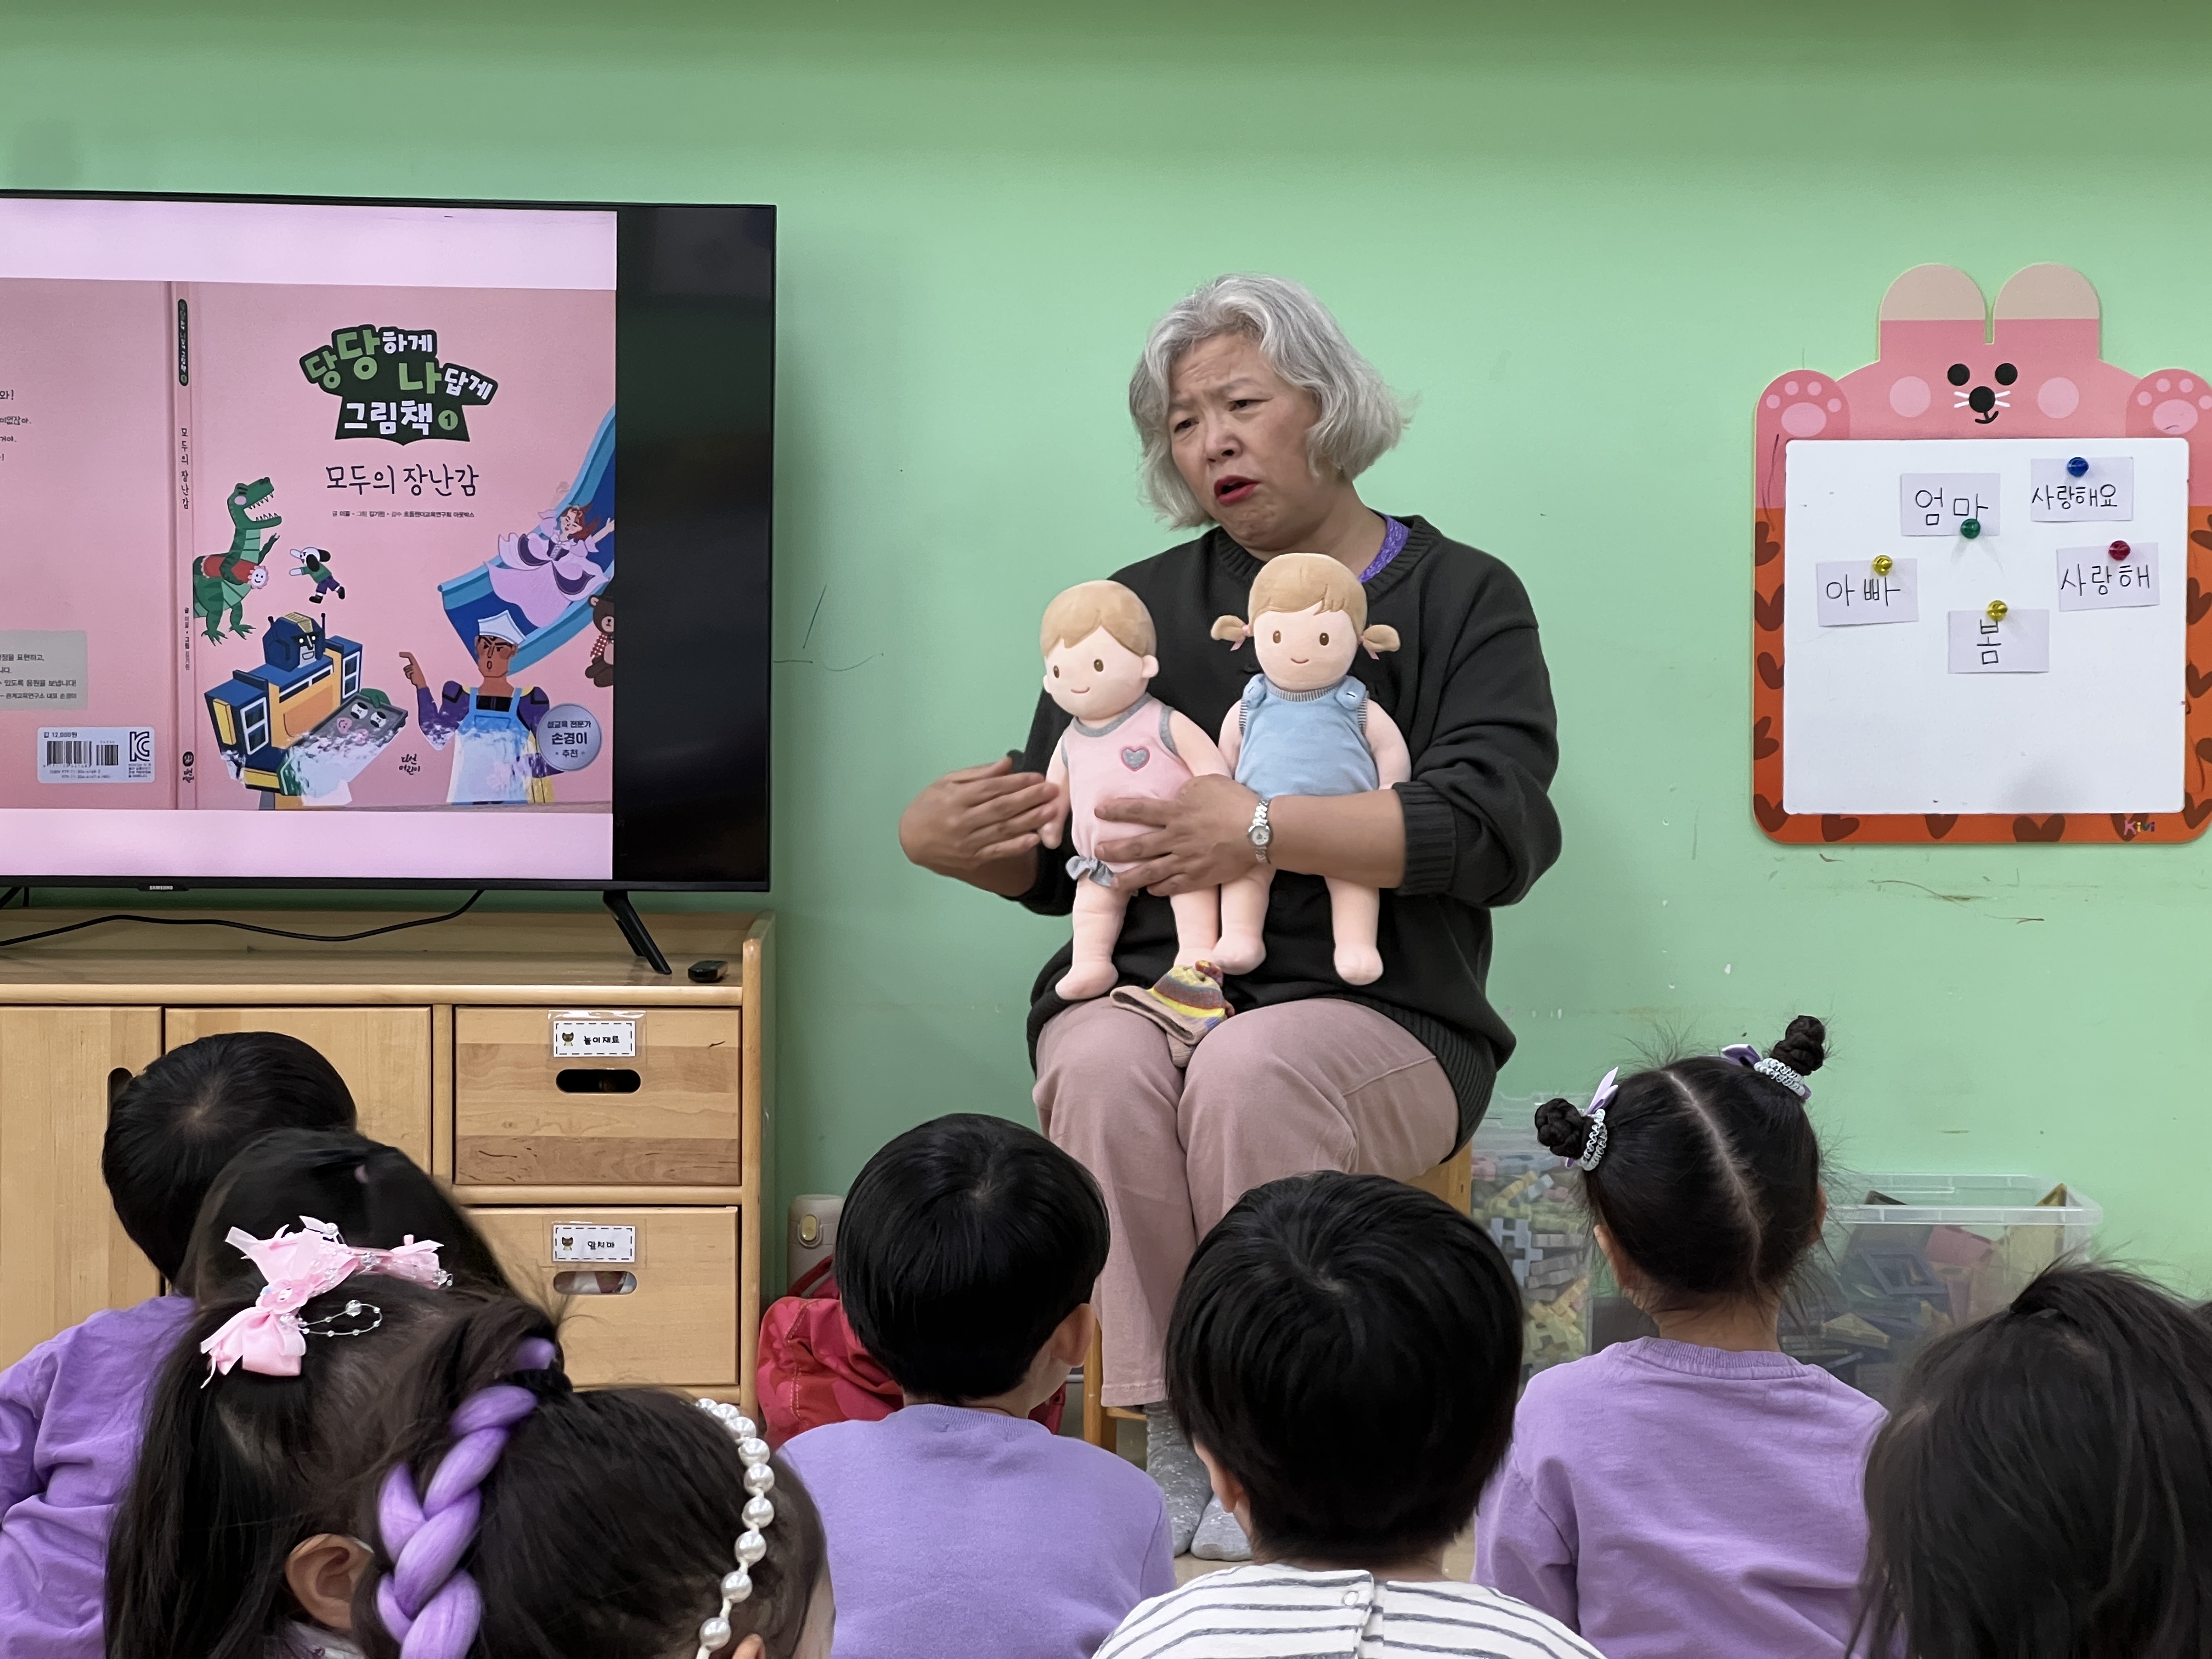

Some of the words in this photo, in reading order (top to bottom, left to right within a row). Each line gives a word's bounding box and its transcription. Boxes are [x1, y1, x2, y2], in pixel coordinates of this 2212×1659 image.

[304, 329, 433, 388] 당당하게
[399, 362, 493, 400] 나답게
[345, 400, 433, 435] 그림책
[181, 470, 189, 509] 장난감
[326, 465, 395, 495] 모두의
[403, 464, 479, 496] 장난감
[2032, 483, 2118, 510] 사랑해요
[1915, 487, 1989, 526] 엄마
[1826, 574, 1901, 607] 아빠
[2061, 563, 2151, 597] 사랑해
[1976, 618, 2002, 665] 봄
[552, 731, 588, 745] 손경이
[562, 749, 578, 758] 추천
